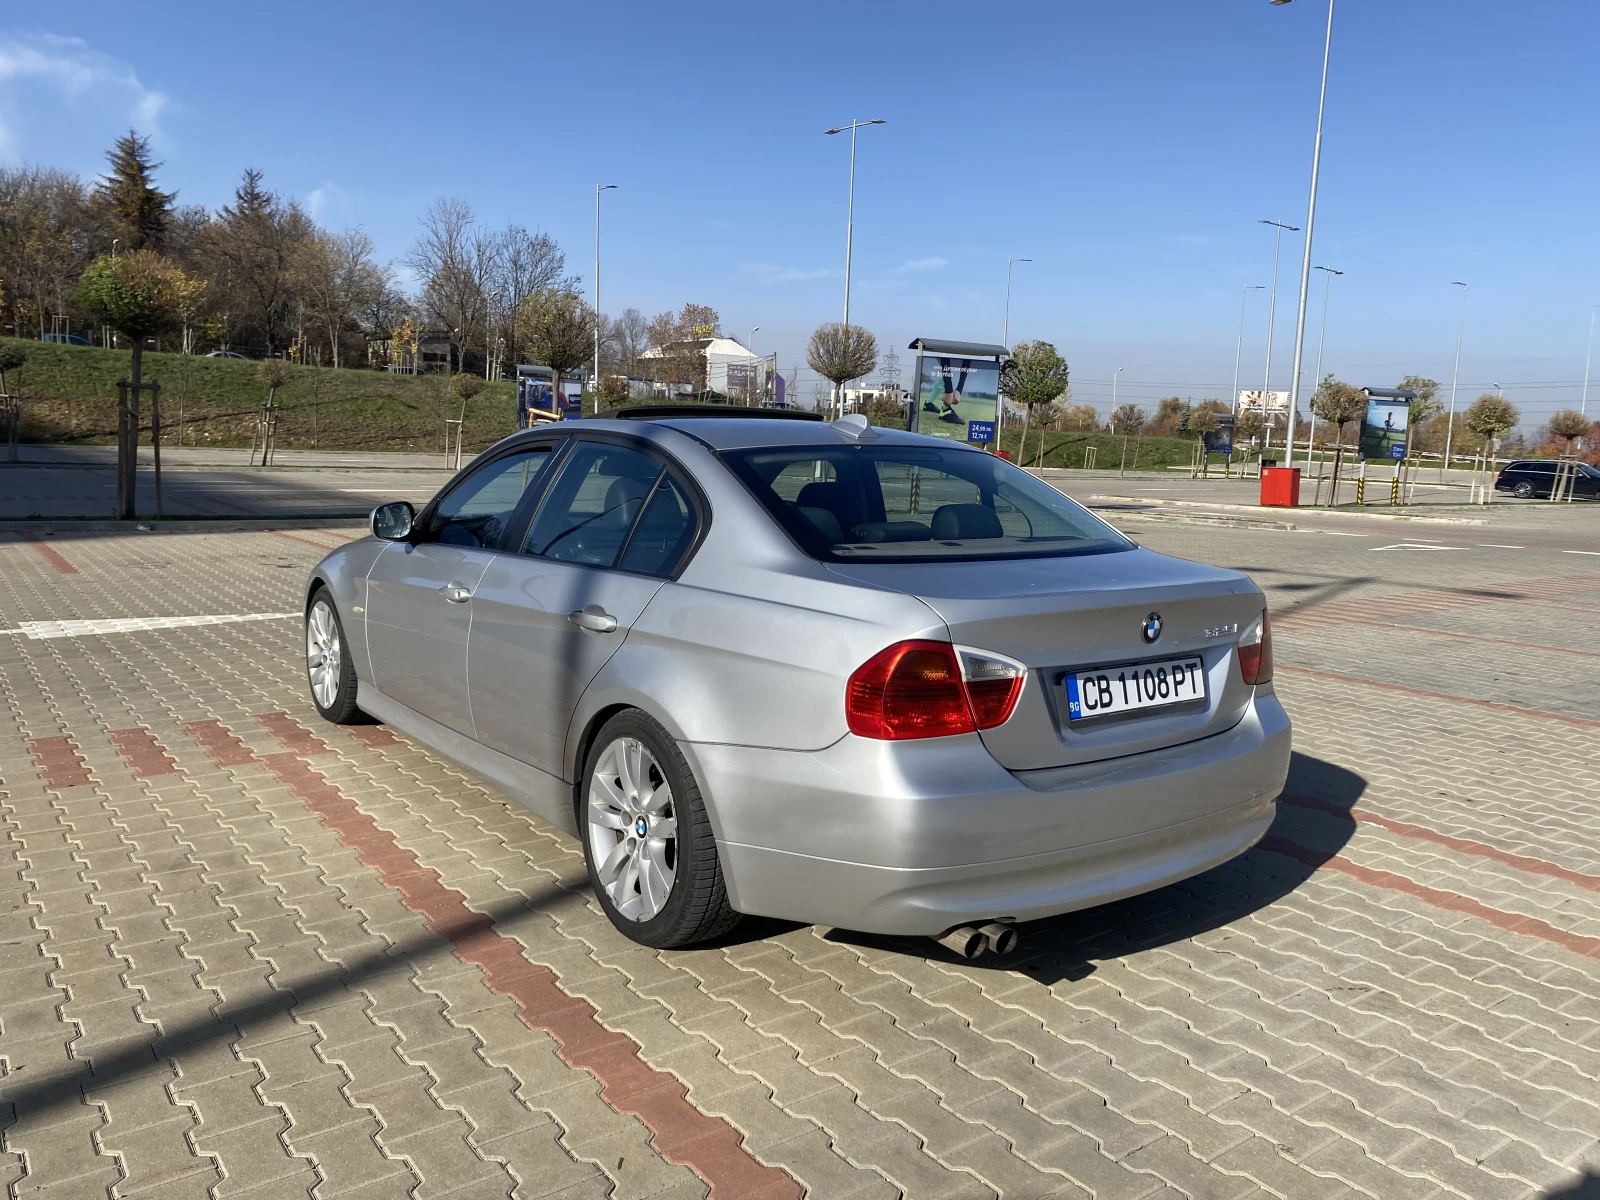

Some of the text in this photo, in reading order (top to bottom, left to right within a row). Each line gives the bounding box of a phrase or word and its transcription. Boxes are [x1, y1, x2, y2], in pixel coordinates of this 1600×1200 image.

[1082, 662, 1198, 711] CB 1108 PT
[1070, 701, 1080, 711] BG
